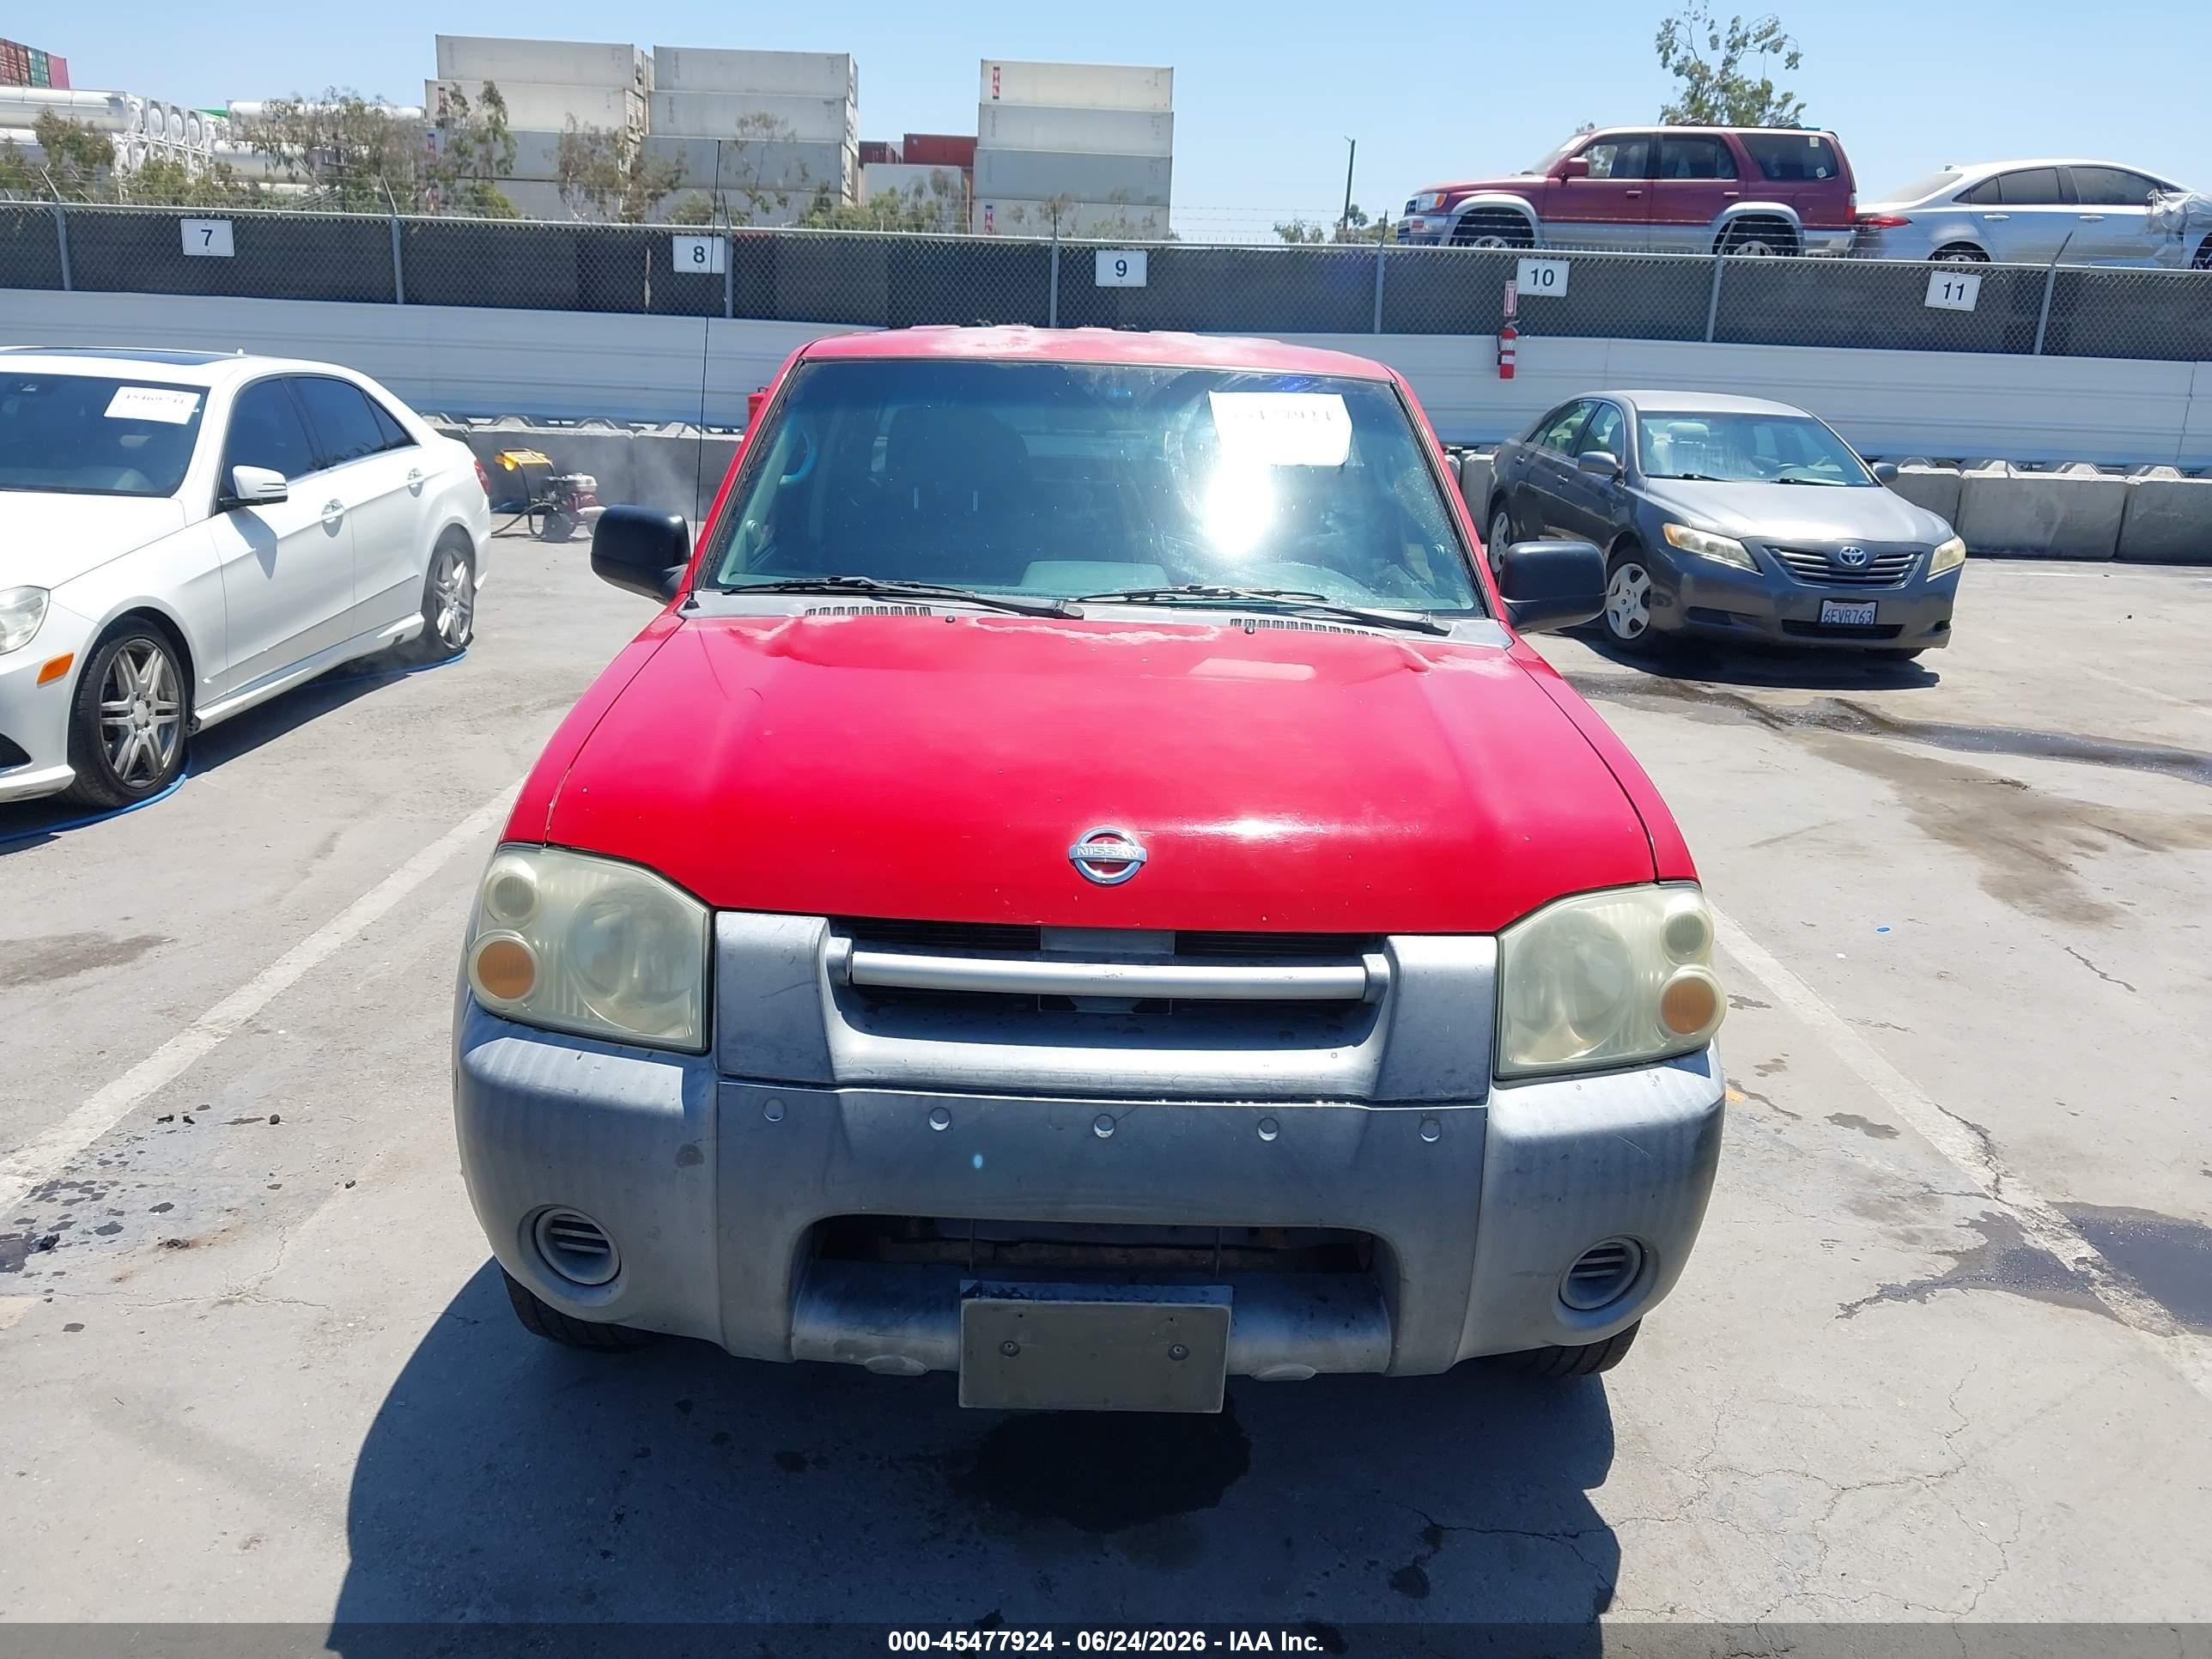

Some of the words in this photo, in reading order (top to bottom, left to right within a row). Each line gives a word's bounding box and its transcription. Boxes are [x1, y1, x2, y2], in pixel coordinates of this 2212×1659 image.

[200, 229, 213, 246] 7
[693, 246, 705, 264] 8
[1115, 259, 1127, 277] 9
[1530, 268, 1554, 287] 10
[1943, 281, 1965, 301] 11
[1823, 608, 1873, 624] 6EVR763
[1077, 845, 1139, 859] NISSAN
